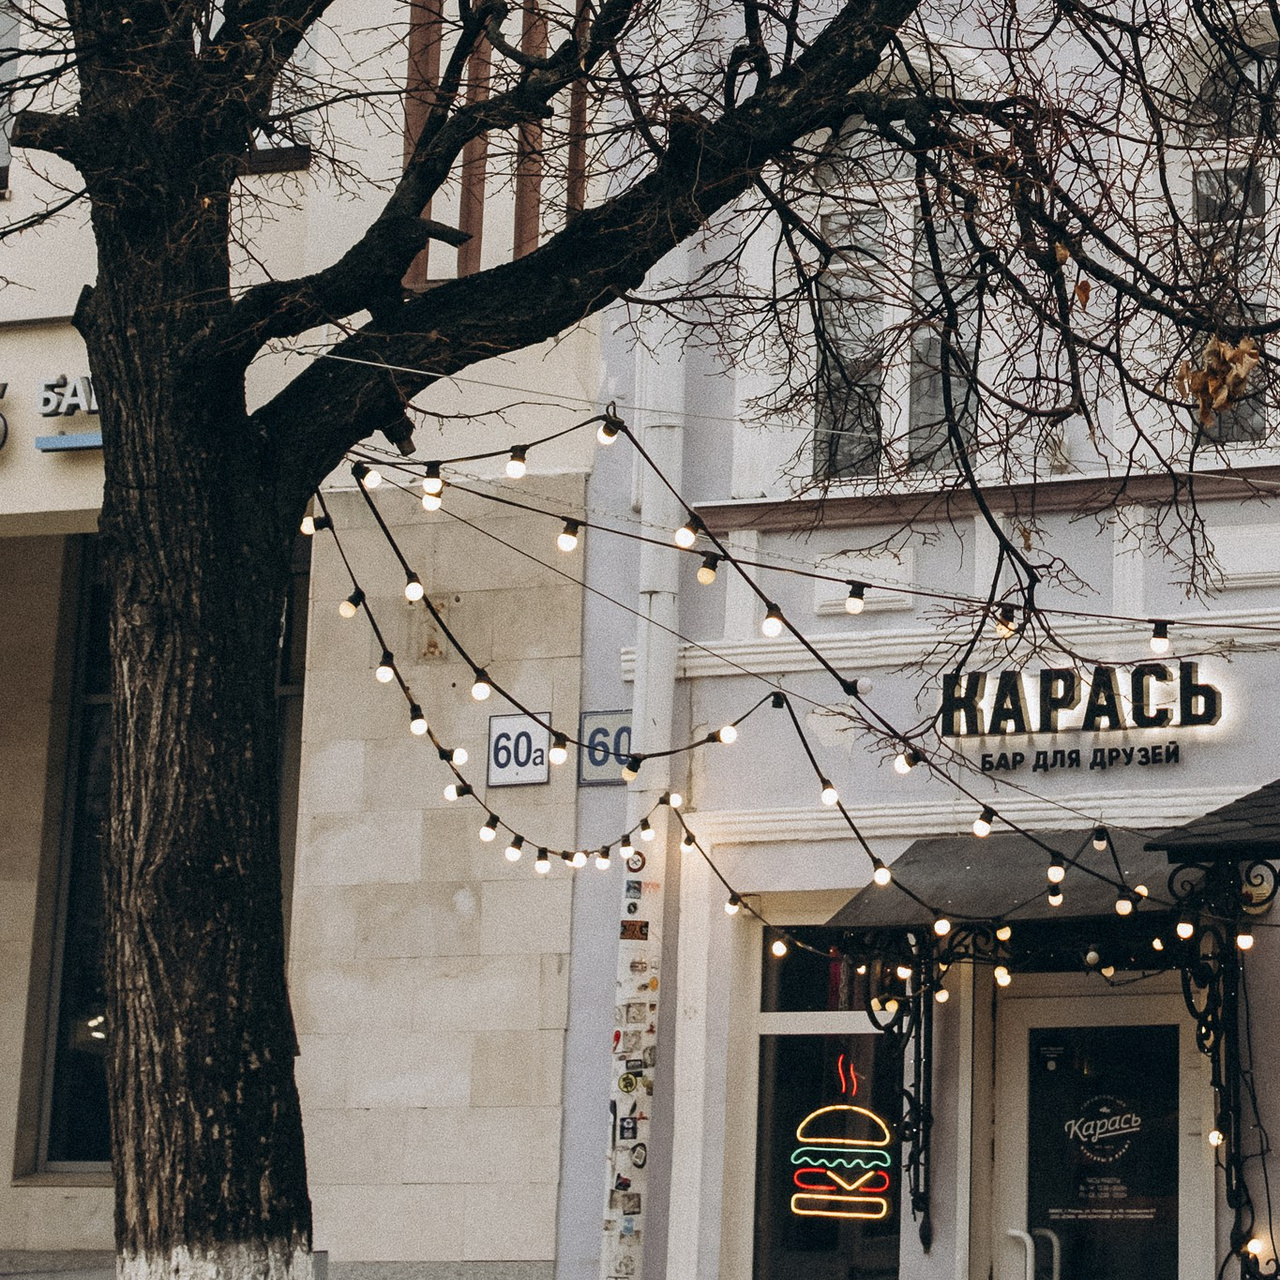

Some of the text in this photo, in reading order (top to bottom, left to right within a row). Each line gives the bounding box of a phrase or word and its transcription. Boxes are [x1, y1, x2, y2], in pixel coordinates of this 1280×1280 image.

[36, 375, 99, 417] БА
[941, 661, 1223, 737] КАРАСЬ
[493, 731, 545, 769] 60а
[588, 726, 631, 767] 60
[981, 741, 1180, 773] БАР ДЛЯ ДРУЗЕЙ
[1064, 1113, 1142, 1143] Карась
